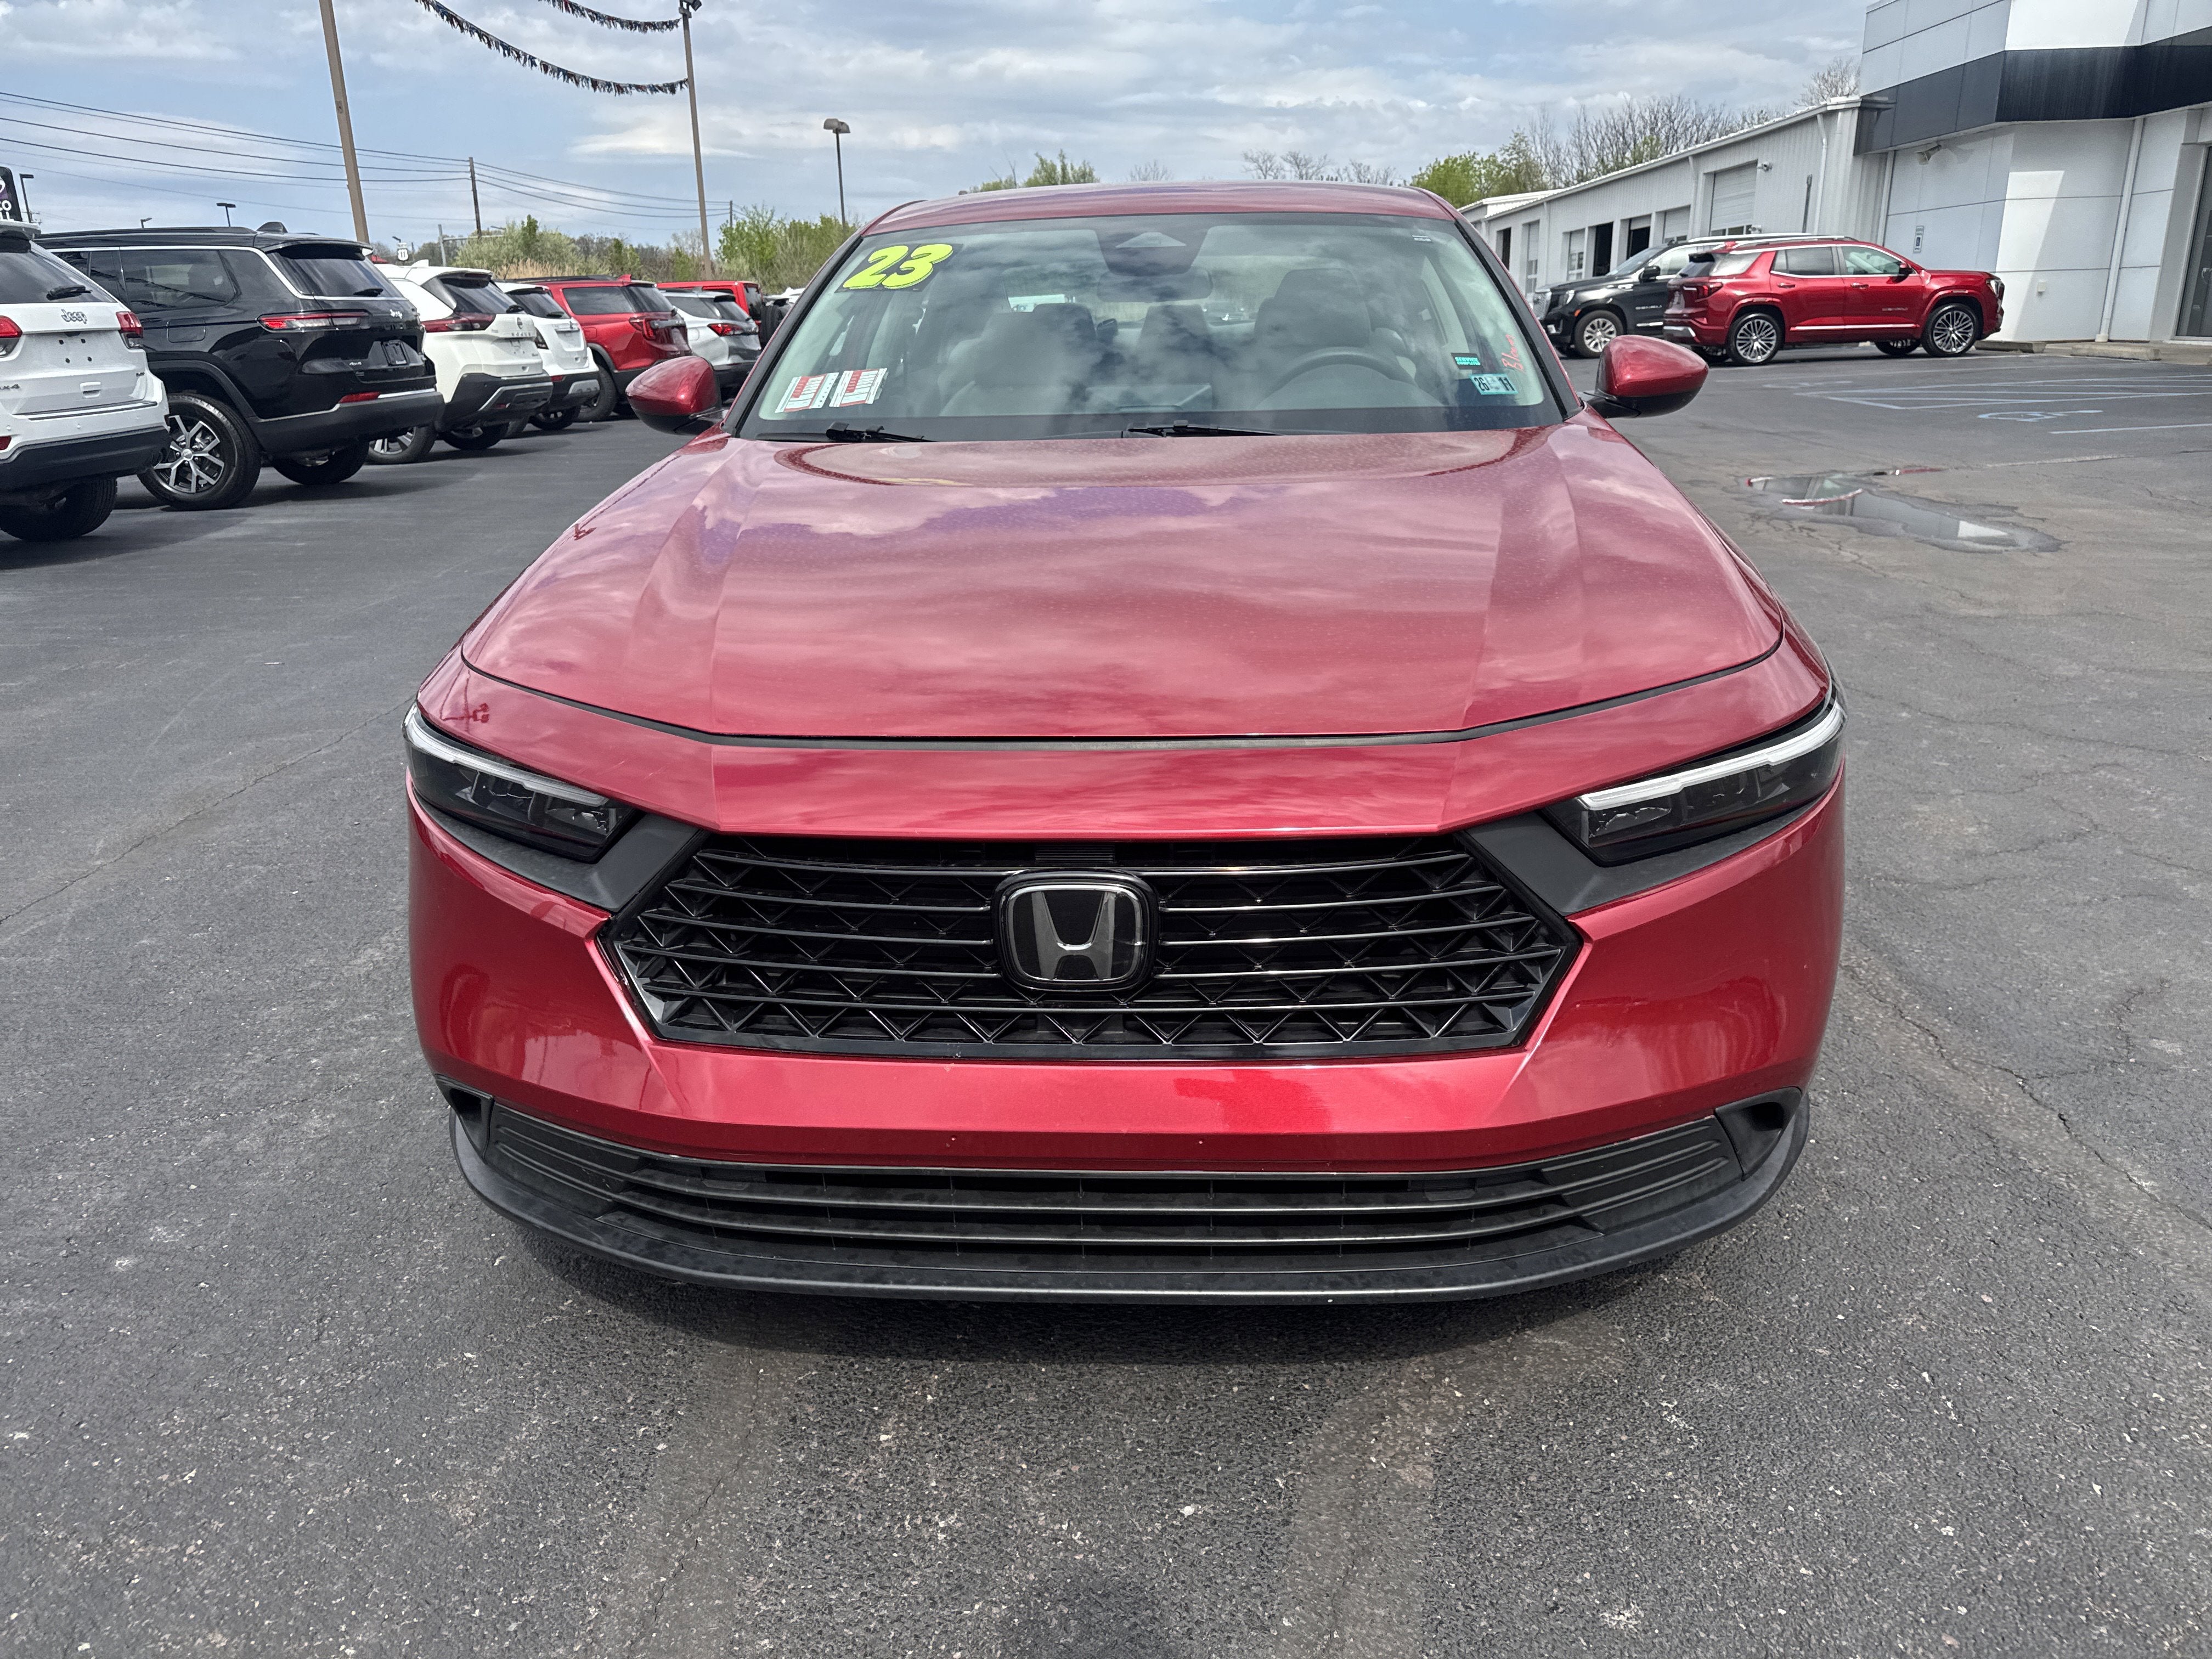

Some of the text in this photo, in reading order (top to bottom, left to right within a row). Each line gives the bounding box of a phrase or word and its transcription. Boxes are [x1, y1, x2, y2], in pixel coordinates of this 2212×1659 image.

[843, 244, 953, 290] 23
[60, 309, 87, 324] Jeep
[1474, 377, 1515, 391] 26 11
